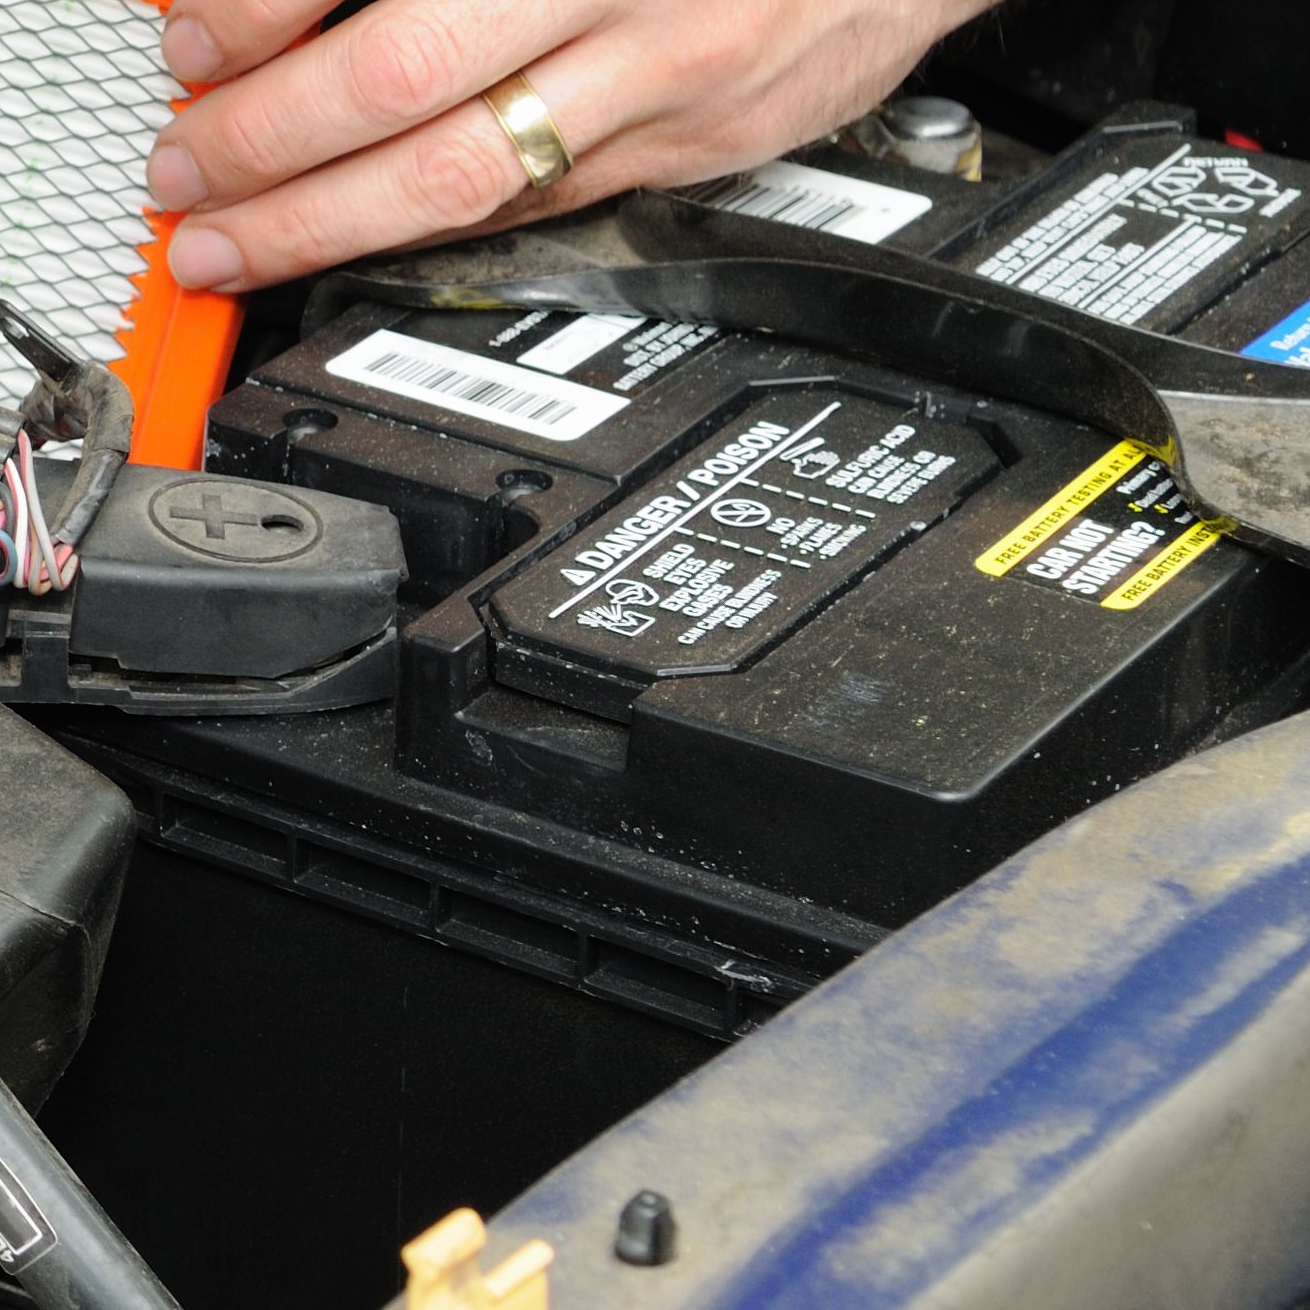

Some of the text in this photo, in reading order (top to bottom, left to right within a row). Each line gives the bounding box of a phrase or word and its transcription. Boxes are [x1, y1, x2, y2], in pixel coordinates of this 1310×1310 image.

[825, 424, 916, 488] SULFURIC ACID
[575, 495, 691, 570] DANGER
[687, 421, 790, 486] POISON
[994, 543, 1026, 565] FREE
[1023, 508, 1067, 543] BATTERY
[1065, 471, 1113, 509] TESTING
[1108, 459, 1128, 475] AT
[766, 517, 796, 535] NO
[1026, 518, 1116, 580] CAR NOT
[642, 543, 695, 579] SHIELD
[659, 558, 735, 611] EXPLOSIVE
[663, 557, 707, 586] EYES
[1062, 520, 1166, 595] STARTING?
[1121, 579, 1153, 601] FREE
[1151, 545, 1193, 579] BATTERY
[677, 569, 781, 644] CAN CAUSE BLINDNESS
[682, 583, 733, 617] GASES
[725, 591, 778, 628] OR INJURY
